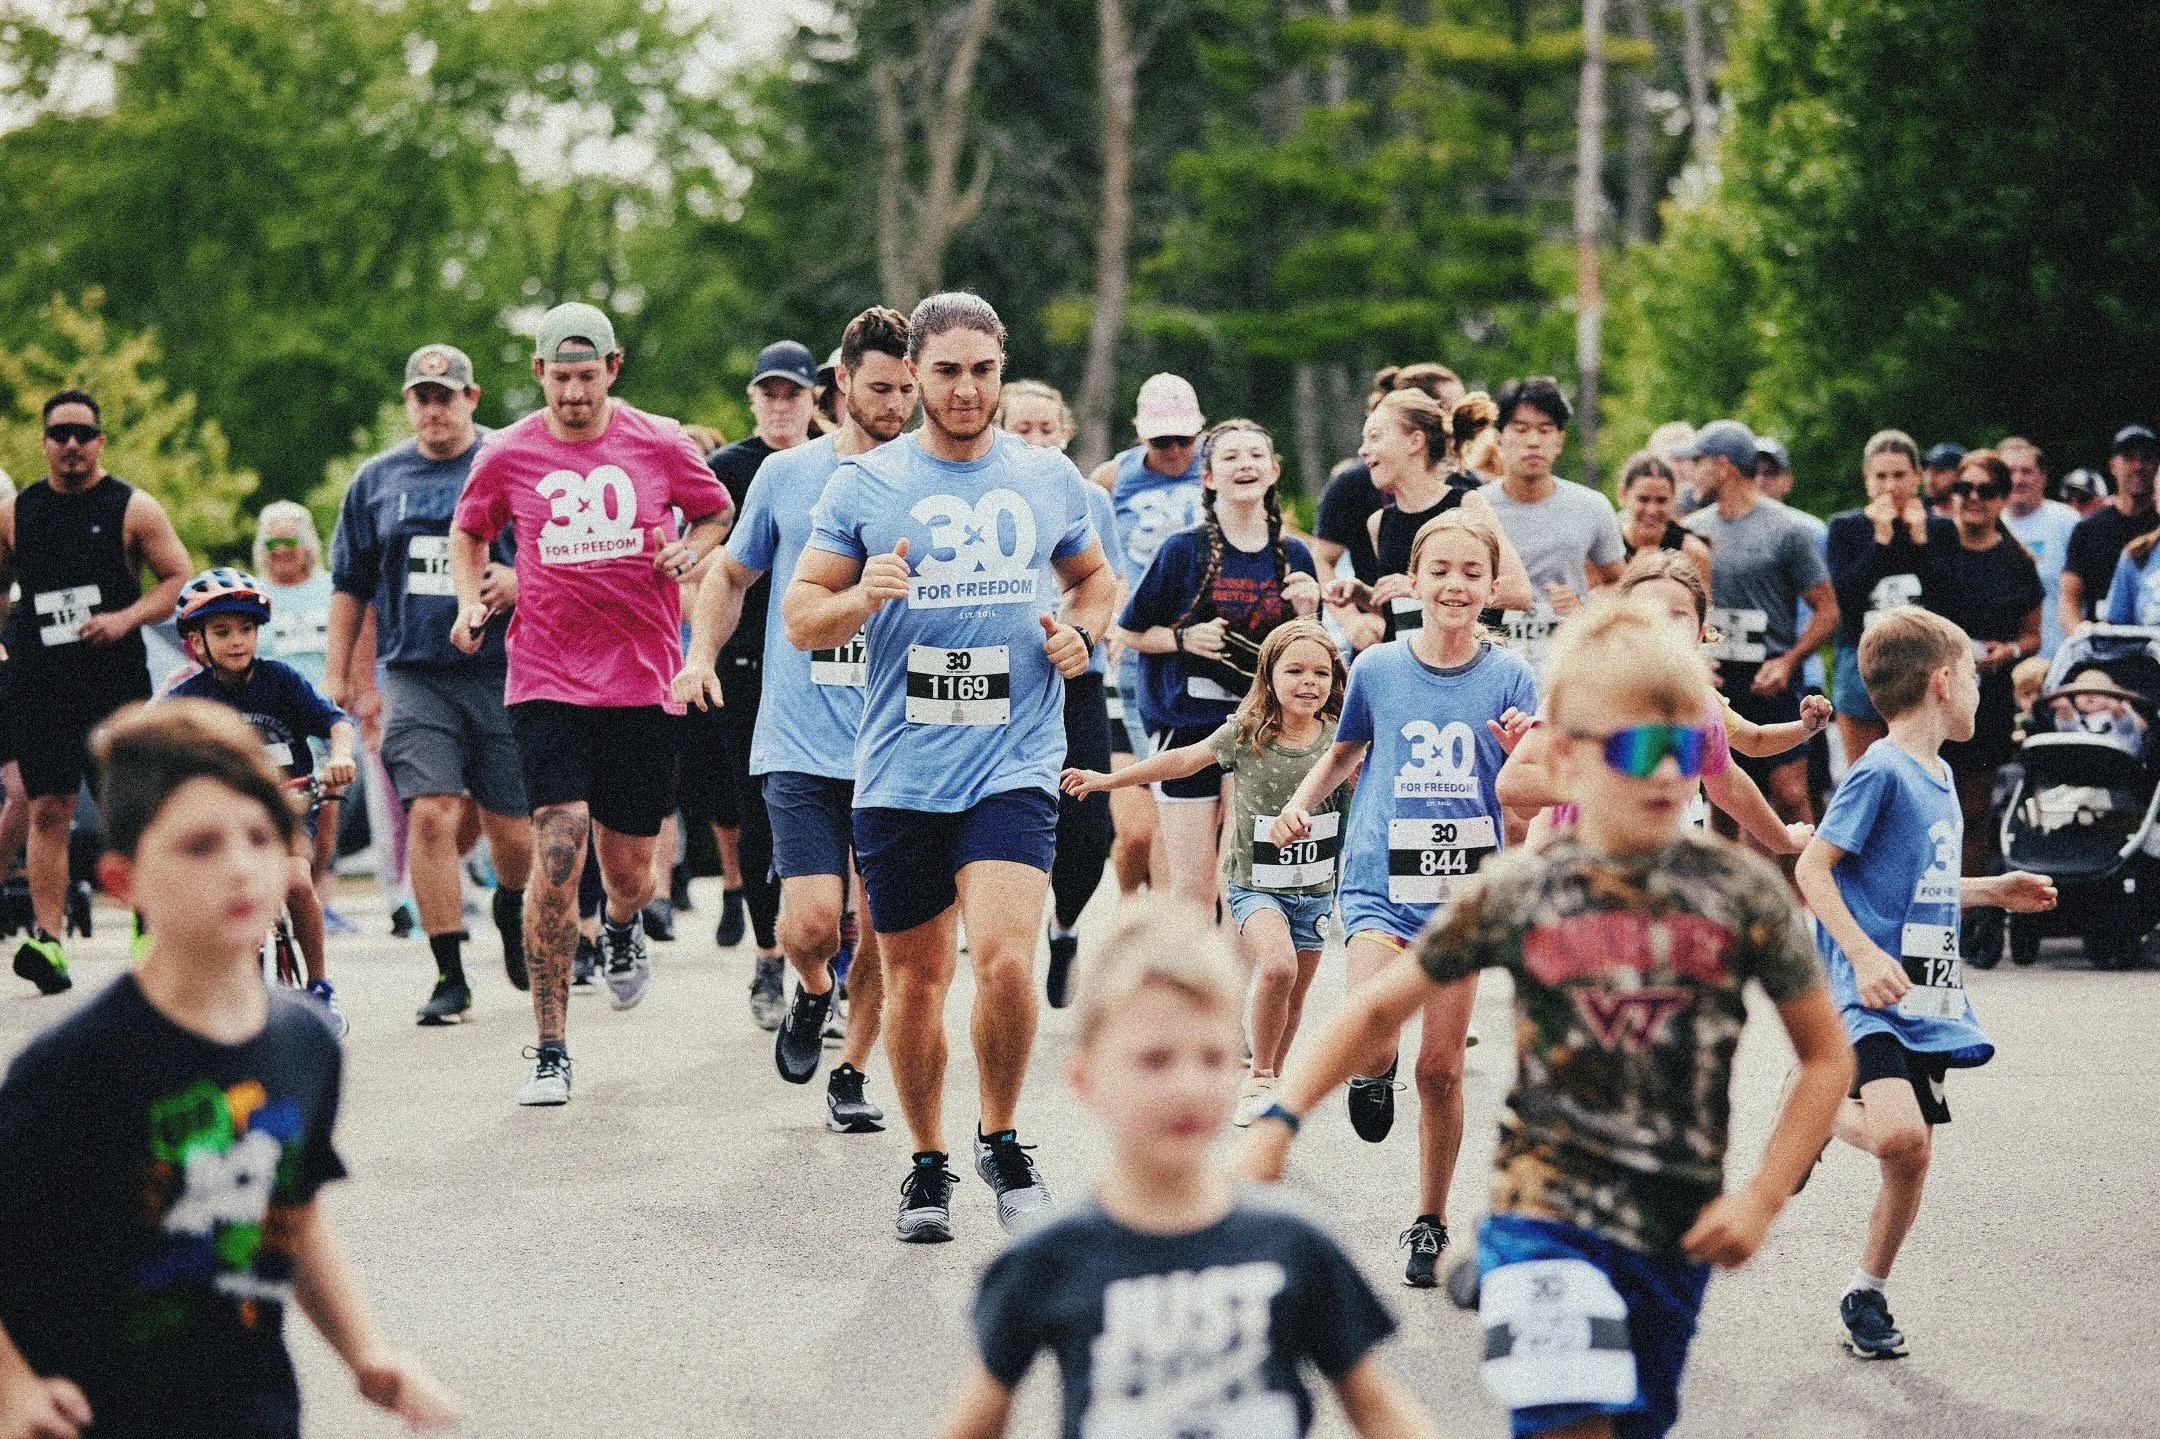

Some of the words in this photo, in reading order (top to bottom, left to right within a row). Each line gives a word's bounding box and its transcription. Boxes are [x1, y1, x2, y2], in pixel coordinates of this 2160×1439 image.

[545, 545, 569, 556] FOR
[574, 538, 637, 554] FREEDOM
[917, 584, 951, 601] FOR
[956, 579, 1033, 598] FREEDOM
[977, 610, 997, 618] 2016
[834, 640, 866, 663] 117
[945, 651, 972, 671] 30
[928, 675, 989, 700] 1169
[1400, 782, 1421, 793] FOR
[1424, 782, 1474, 793] FREEDOM
[1430, 823, 1458, 843] 30
[1278, 841, 1318, 865] 510
[1419, 849, 1468, 876] 844
